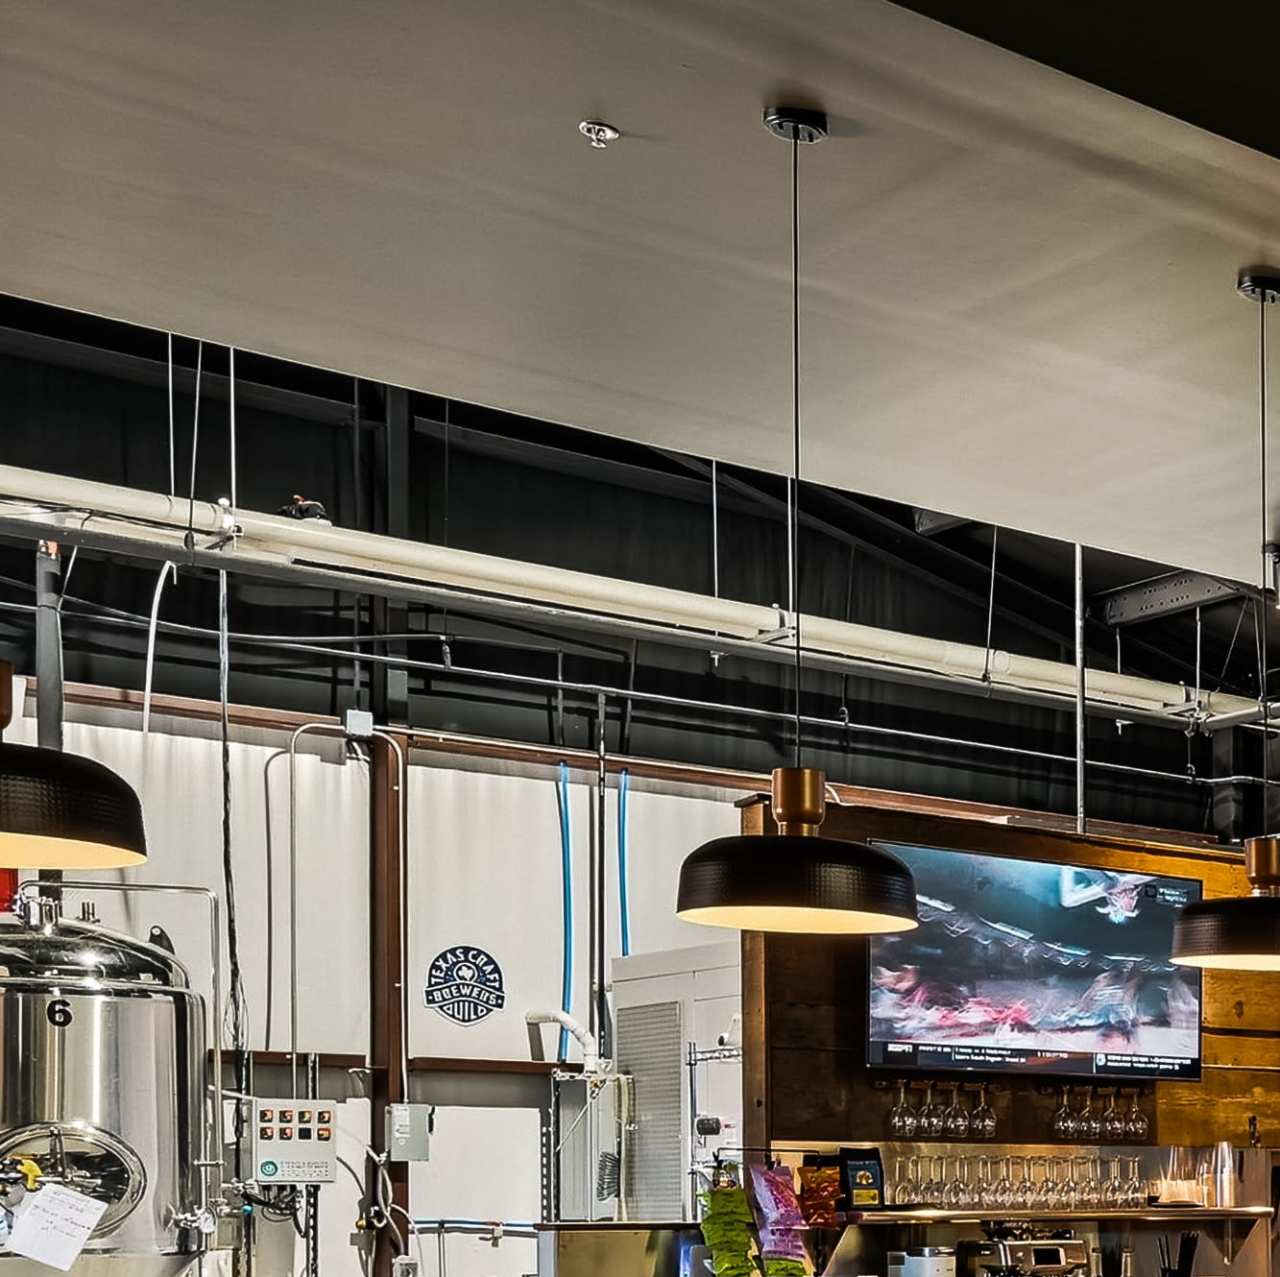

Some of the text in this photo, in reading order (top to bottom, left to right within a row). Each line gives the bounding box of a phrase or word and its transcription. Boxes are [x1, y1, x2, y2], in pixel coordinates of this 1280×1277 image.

[431, 948, 500, 988] TEXAS CRAFT
[432, 984, 497, 1005] BREWERS
[47, 999, 73, 1027] 6
[442, 1001, 487, 1020] GUILD
